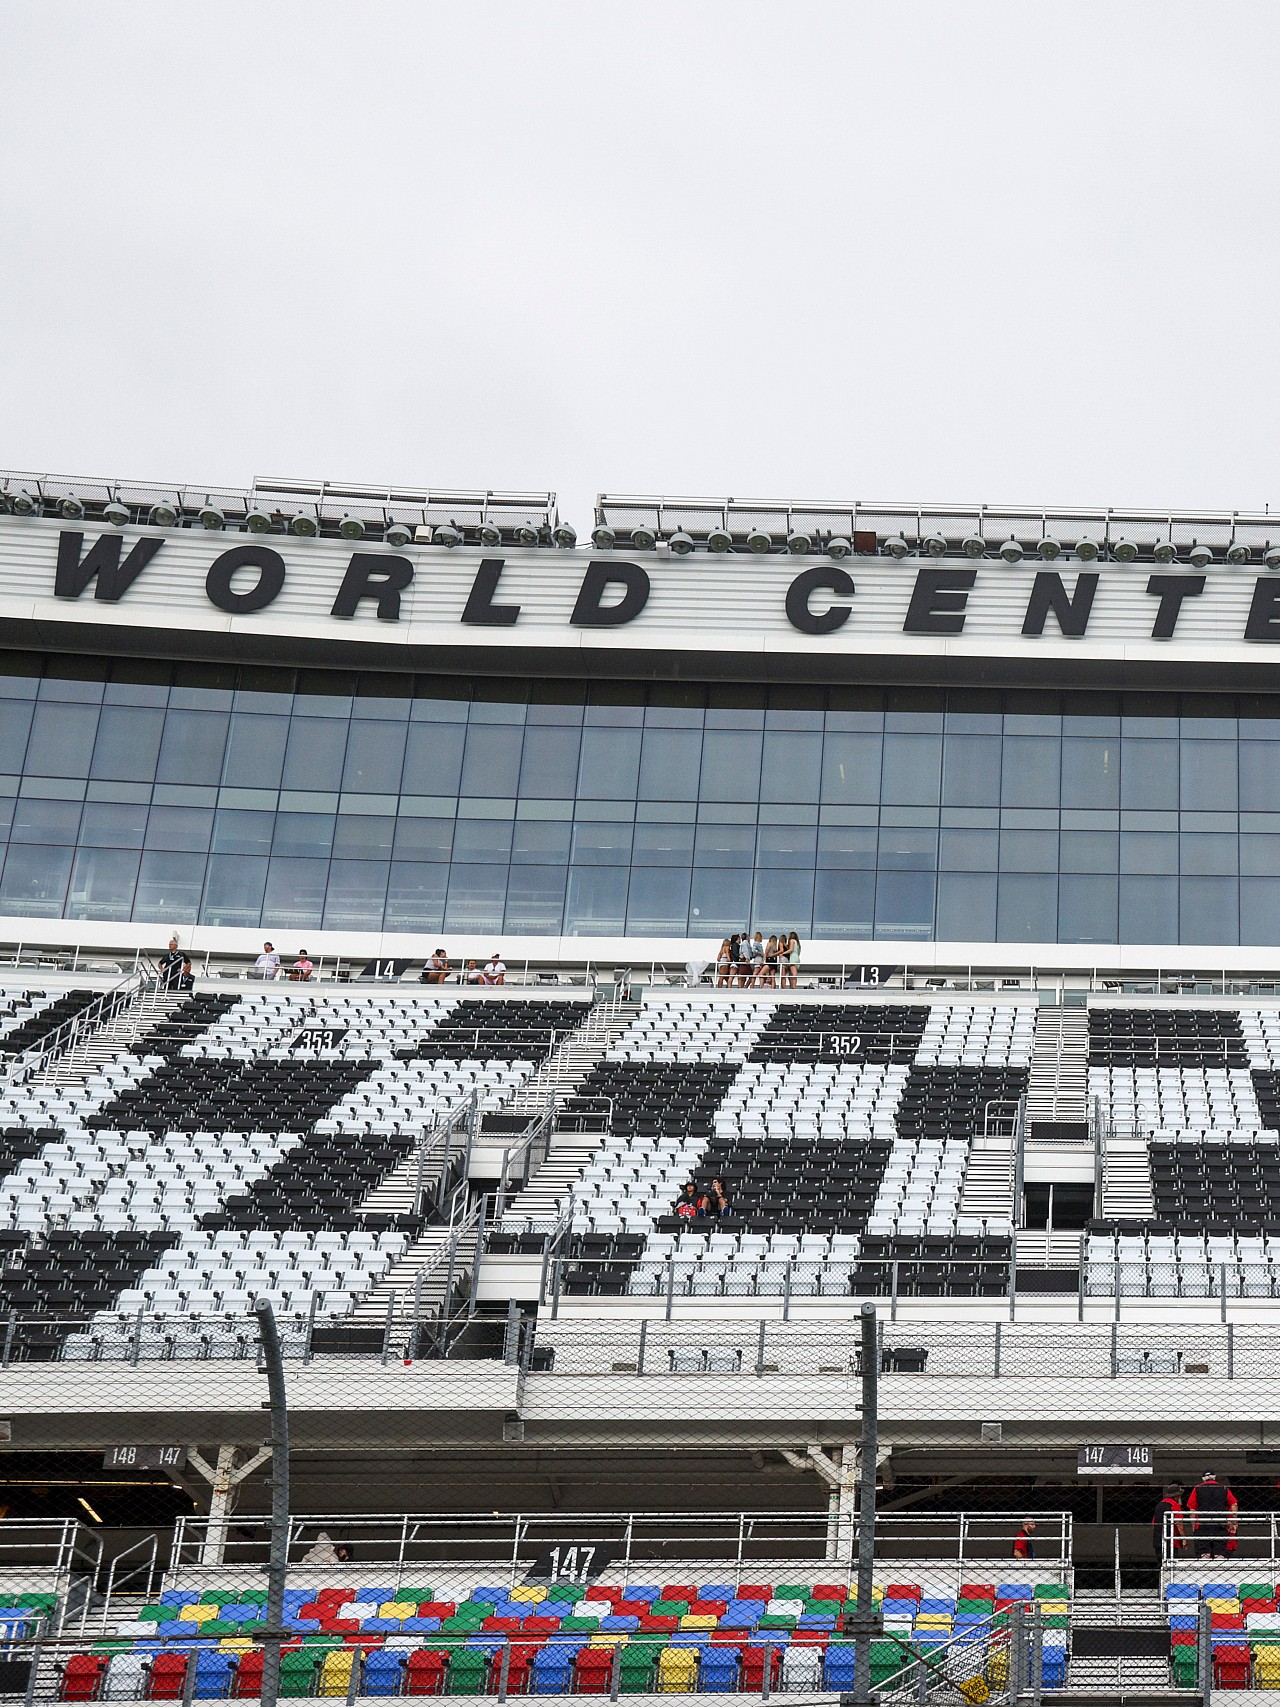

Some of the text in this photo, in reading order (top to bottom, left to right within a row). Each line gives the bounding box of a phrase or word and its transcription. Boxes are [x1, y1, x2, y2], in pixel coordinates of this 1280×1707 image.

[54, 531, 650, 626] WORLD
[374, 960, 395, 980] L4
[860, 966, 880, 986] L3
[300, 1030, 334, 1050] 353
[829, 1035, 861, 1055] 352
[112, 1446, 181, 1465] 148 147
[1084, 1446, 1149, 1464] 147 146
[549, 1546, 596, 1584] 147
